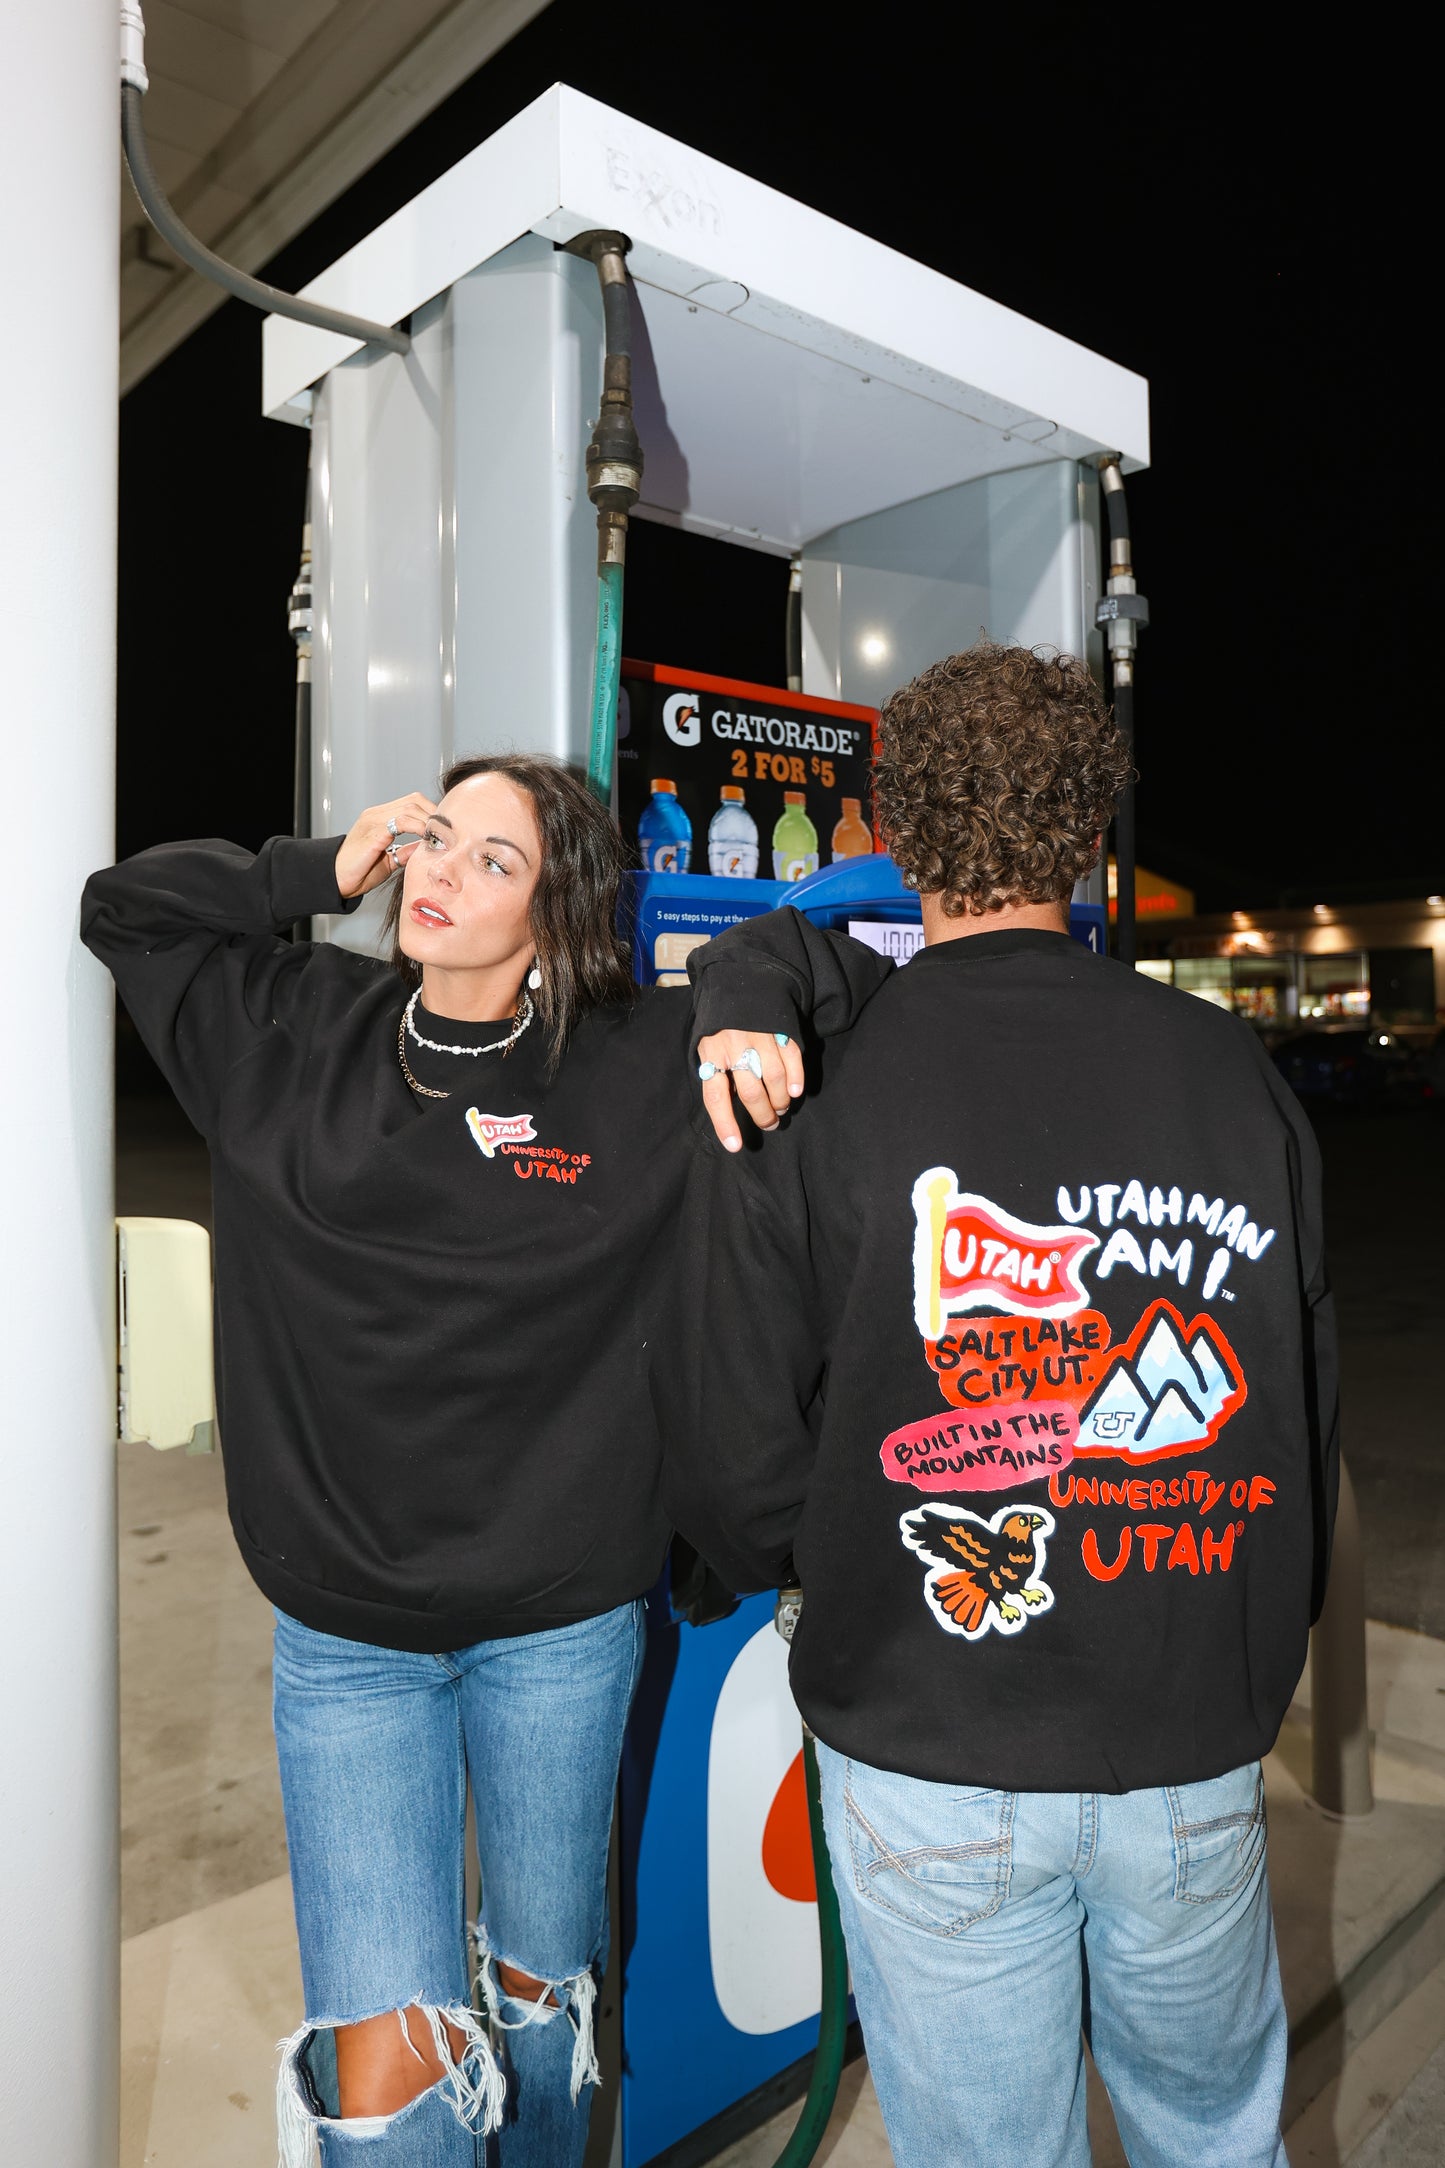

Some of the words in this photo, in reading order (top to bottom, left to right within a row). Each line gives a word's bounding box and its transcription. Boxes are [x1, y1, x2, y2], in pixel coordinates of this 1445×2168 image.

[731, 749, 748, 778] 2
[754, 752, 807, 784] FOR
[811, 755, 836, 788] $5
[657, 910, 663, 920] 5
[663, 912, 680, 923] easy
[681, 913, 699, 923] steps
[701, 914, 708, 922] to
[710, 915, 723, 924] pay
[723, 915, 731, 923] at
[732, 914, 743, 923] the
[481, 1124, 522, 1139] UTAH
[501, 1143, 569, 1164] UNIVERSITY
[571, 1154, 591, 1167] OF
[1057, 1180, 1182, 1226] UTAH
[1187, 1193, 1275, 1260] MAN
[1096, 1229, 1193, 1285] AM
[935, 1329, 1016, 1369] SALT
[1023, 1319, 1100, 1353] LAKE
[957, 1363, 1037, 1402] CITY
[1043, 1354, 1095, 1386] UT.
[894, 1424, 964, 1464] BUILT
[969, 1419, 1003, 1441] IN
[1007, 1412, 1070, 1438] THE
[907, 1443, 1063, 1479] MOUNTAINS
[1048, 1471, 1225, 1515] UNIVERSITY
[1230, 1476, 1277, 1513] OF
